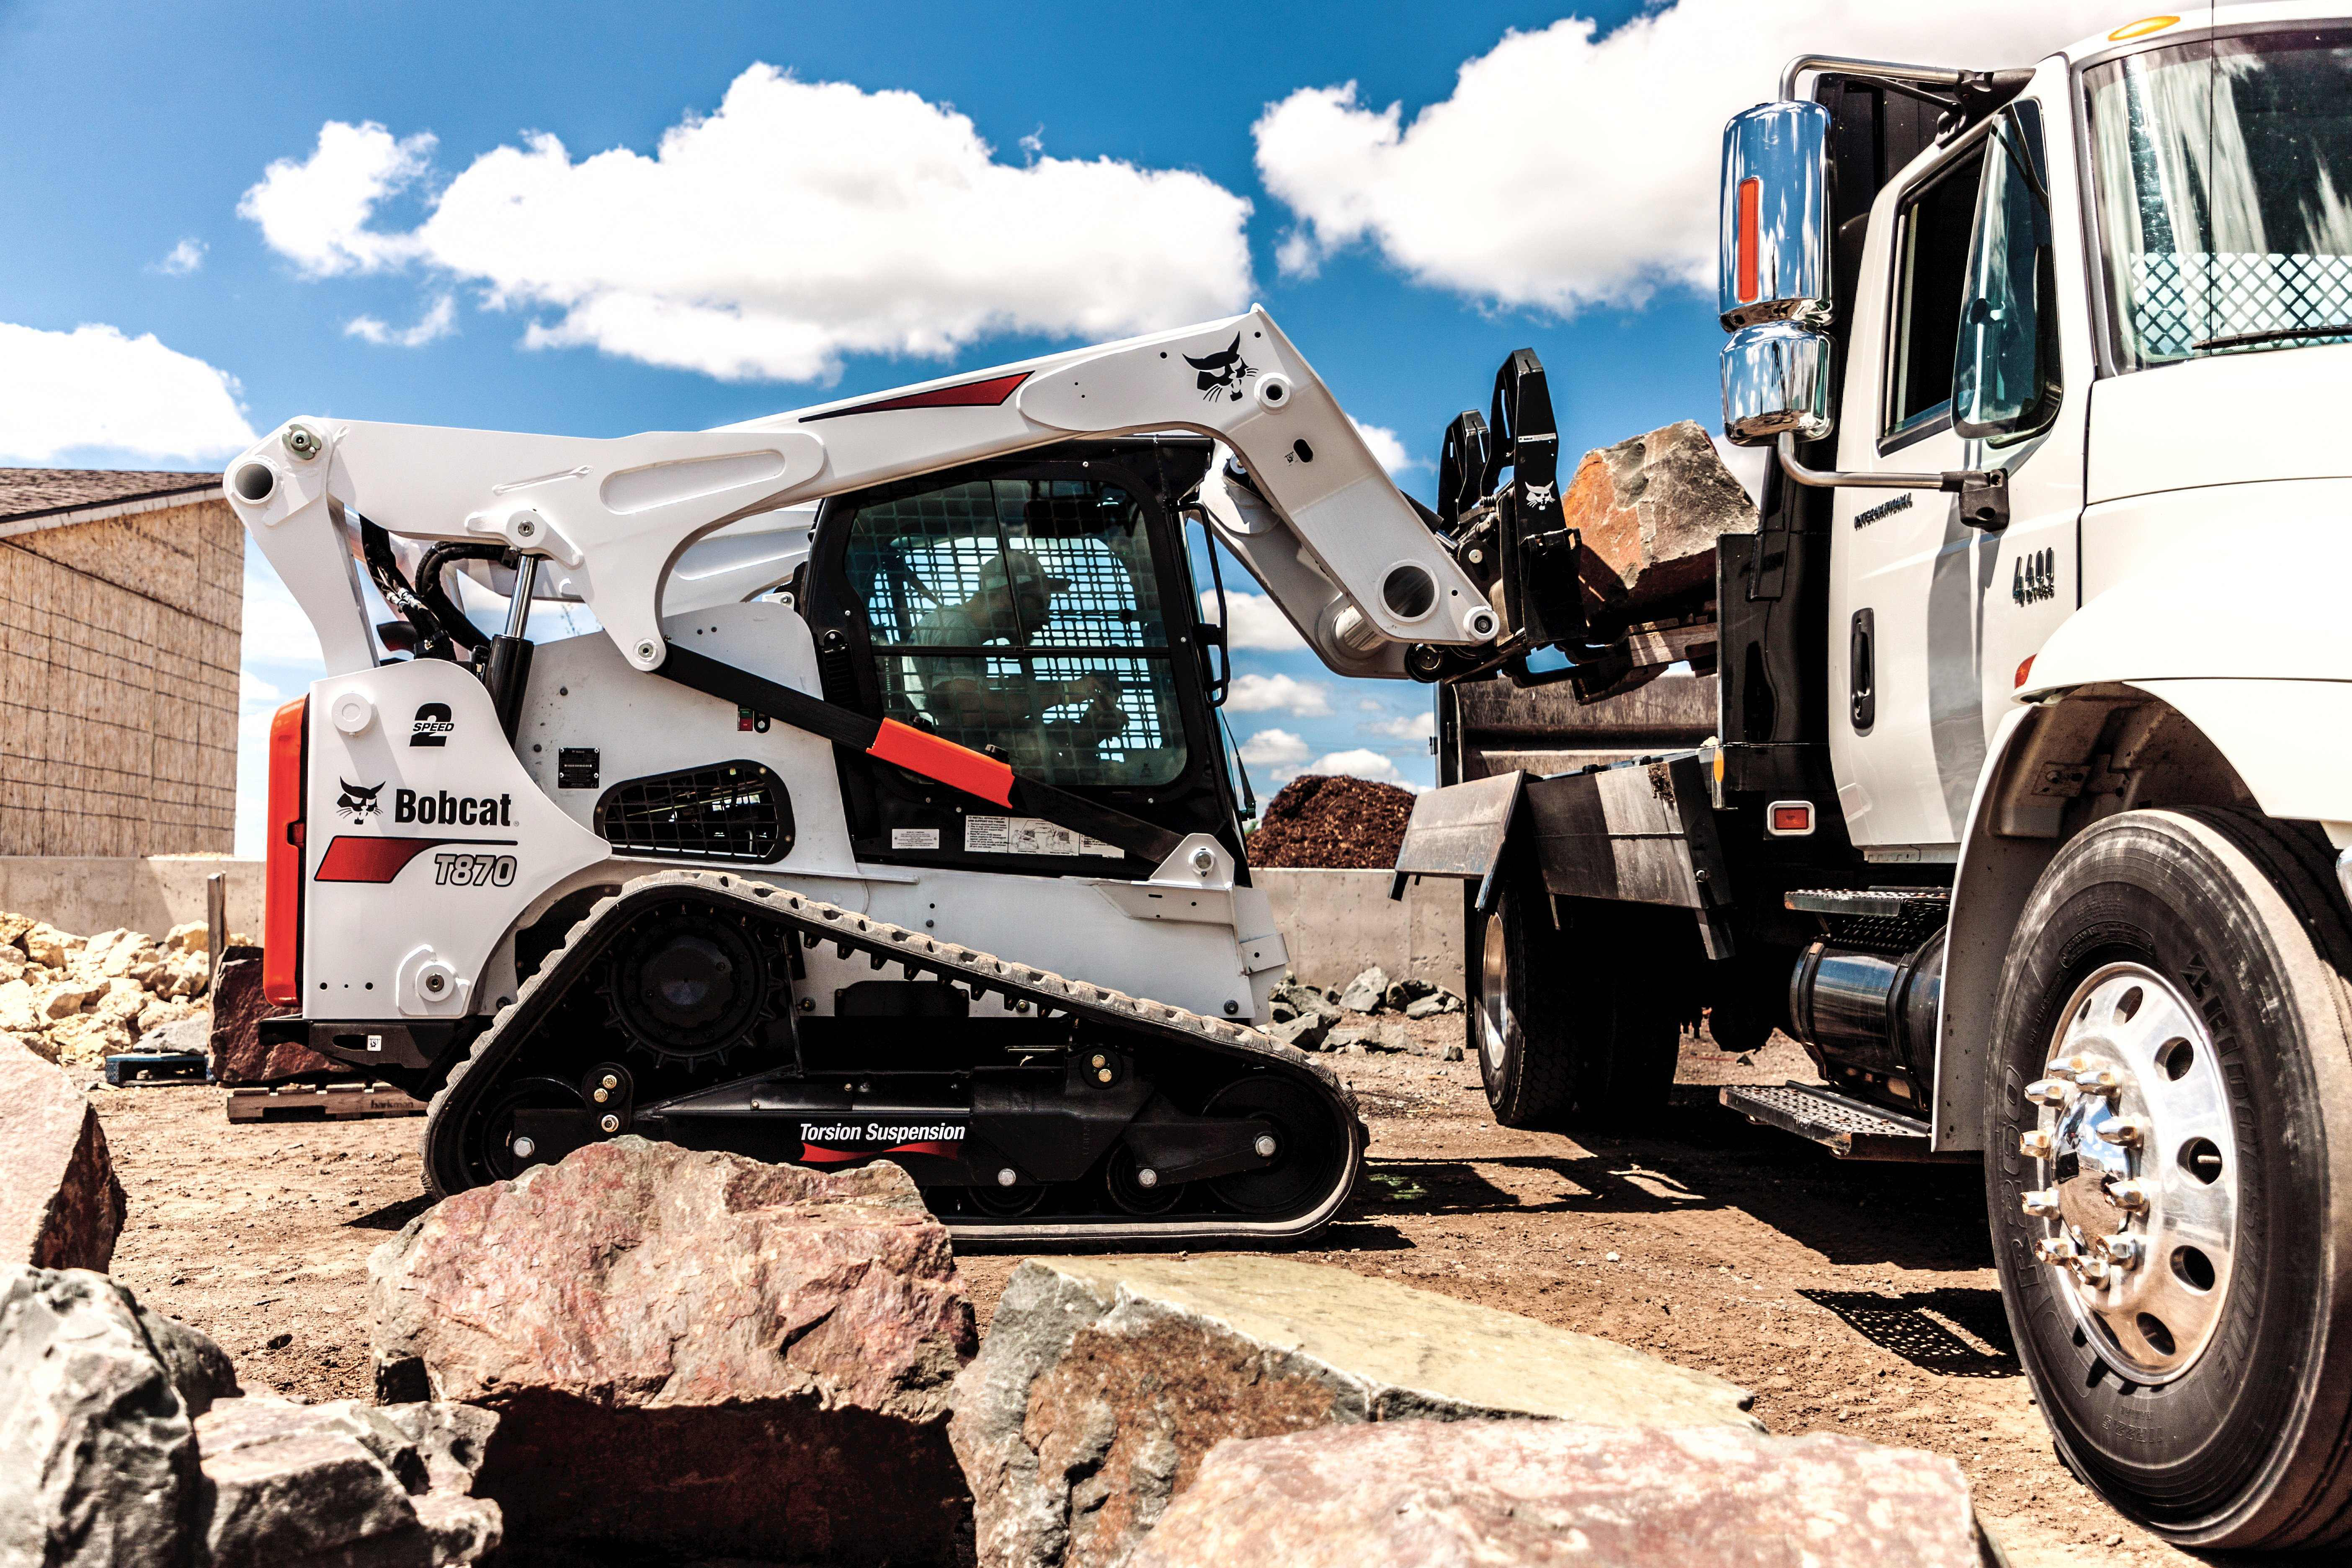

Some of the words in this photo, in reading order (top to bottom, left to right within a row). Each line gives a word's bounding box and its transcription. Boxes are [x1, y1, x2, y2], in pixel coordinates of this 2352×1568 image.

[1854, 493, 1913, 531] INTERNATIONAL
[2012, 547, 2054, 606] 4400
[409, 703, 452, 747] 2
[413, 722, 454, 732] SPEED
[395, 789, 511, 826] Bobcat
[434, 853, 518, 887] T870
[371, 1099, 414, 1109] barkman
[800, 1123, 861, 1140] Torsion
[865, 1122, 966, 1144] Suspension
